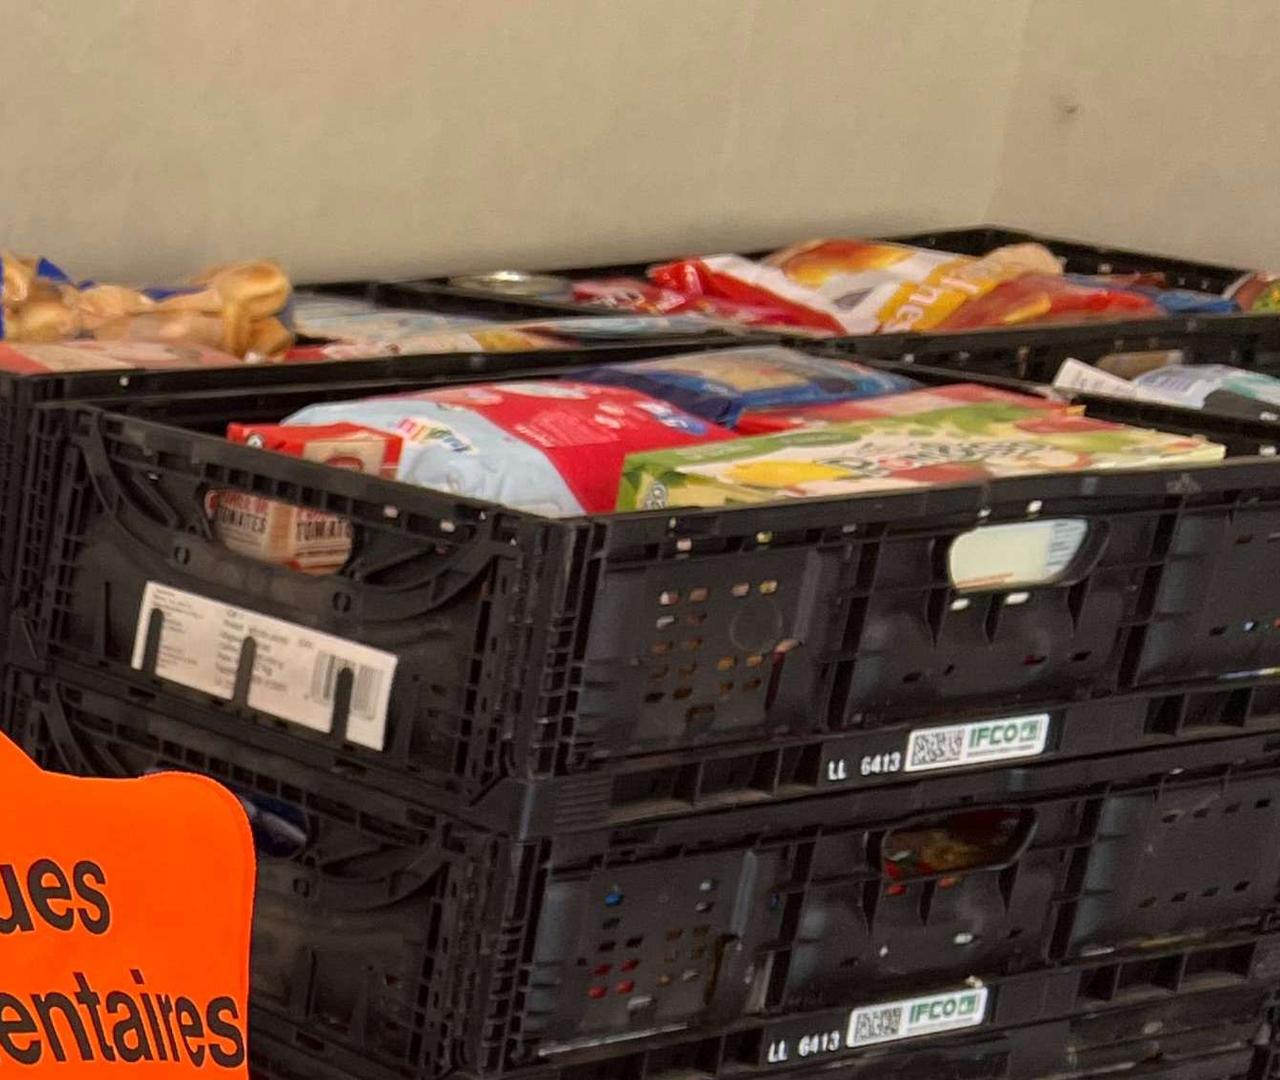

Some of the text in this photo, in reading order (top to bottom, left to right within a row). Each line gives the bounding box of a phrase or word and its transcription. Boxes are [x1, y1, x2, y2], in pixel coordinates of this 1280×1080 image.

[969, 724, 1018, 748] IFCO
[828, 752, 901, 780] LL 6413
[909, 999, 957, 1023] IFCO
[768, 1030, 840, 1063] LL 6413
